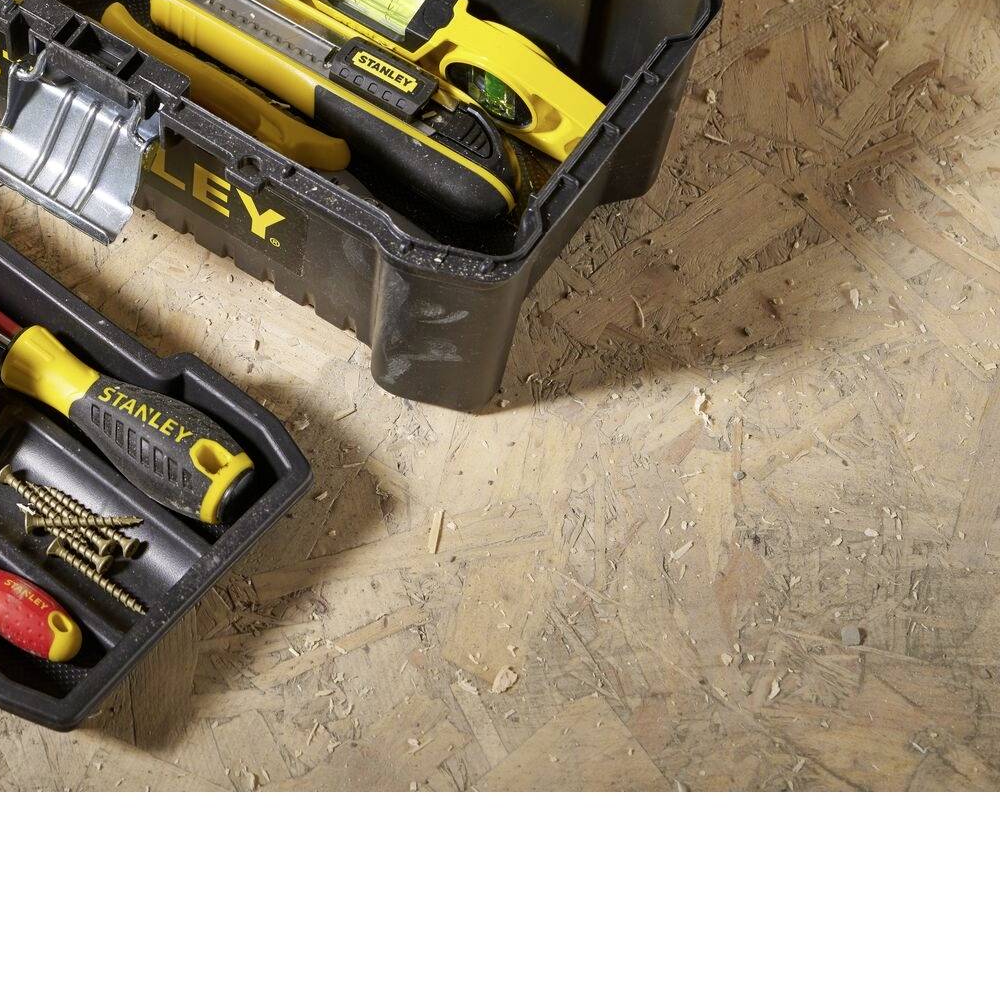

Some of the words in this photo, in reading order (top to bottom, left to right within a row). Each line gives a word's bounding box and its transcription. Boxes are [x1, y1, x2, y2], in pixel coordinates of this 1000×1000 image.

[358, 55, 414, 87] STANLEY
[97, 386, 193, 443] STANLEY
[3, 579, 49, 610] STANLEY
